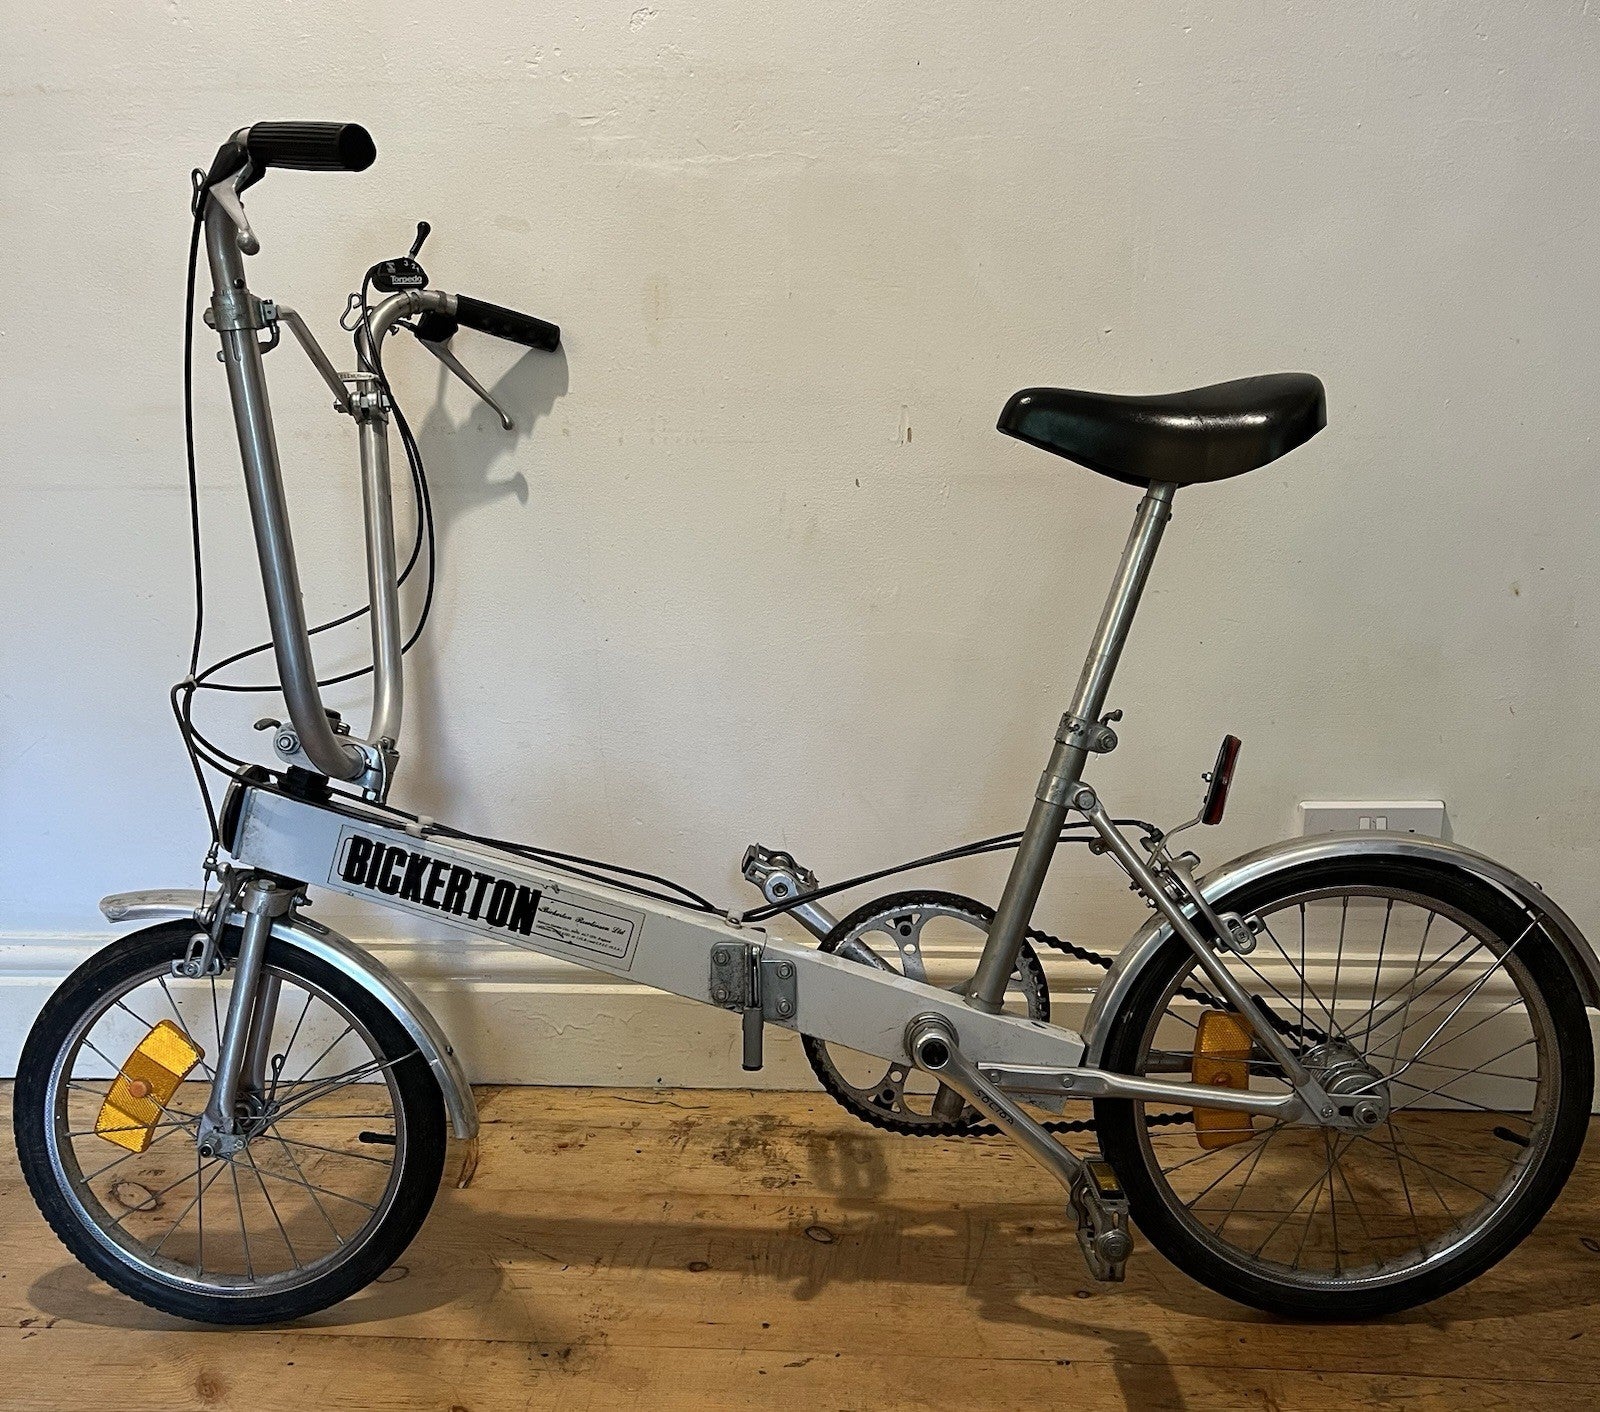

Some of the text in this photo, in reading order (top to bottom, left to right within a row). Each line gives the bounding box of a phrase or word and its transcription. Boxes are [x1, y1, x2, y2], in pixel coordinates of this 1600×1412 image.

[390, 275, 423, 284] Torpedo
[342, 834, 542, 936] BICKERTON
[538, 906, 572, 921] Bickerton
[612, 926, 626, 936] Ltd
